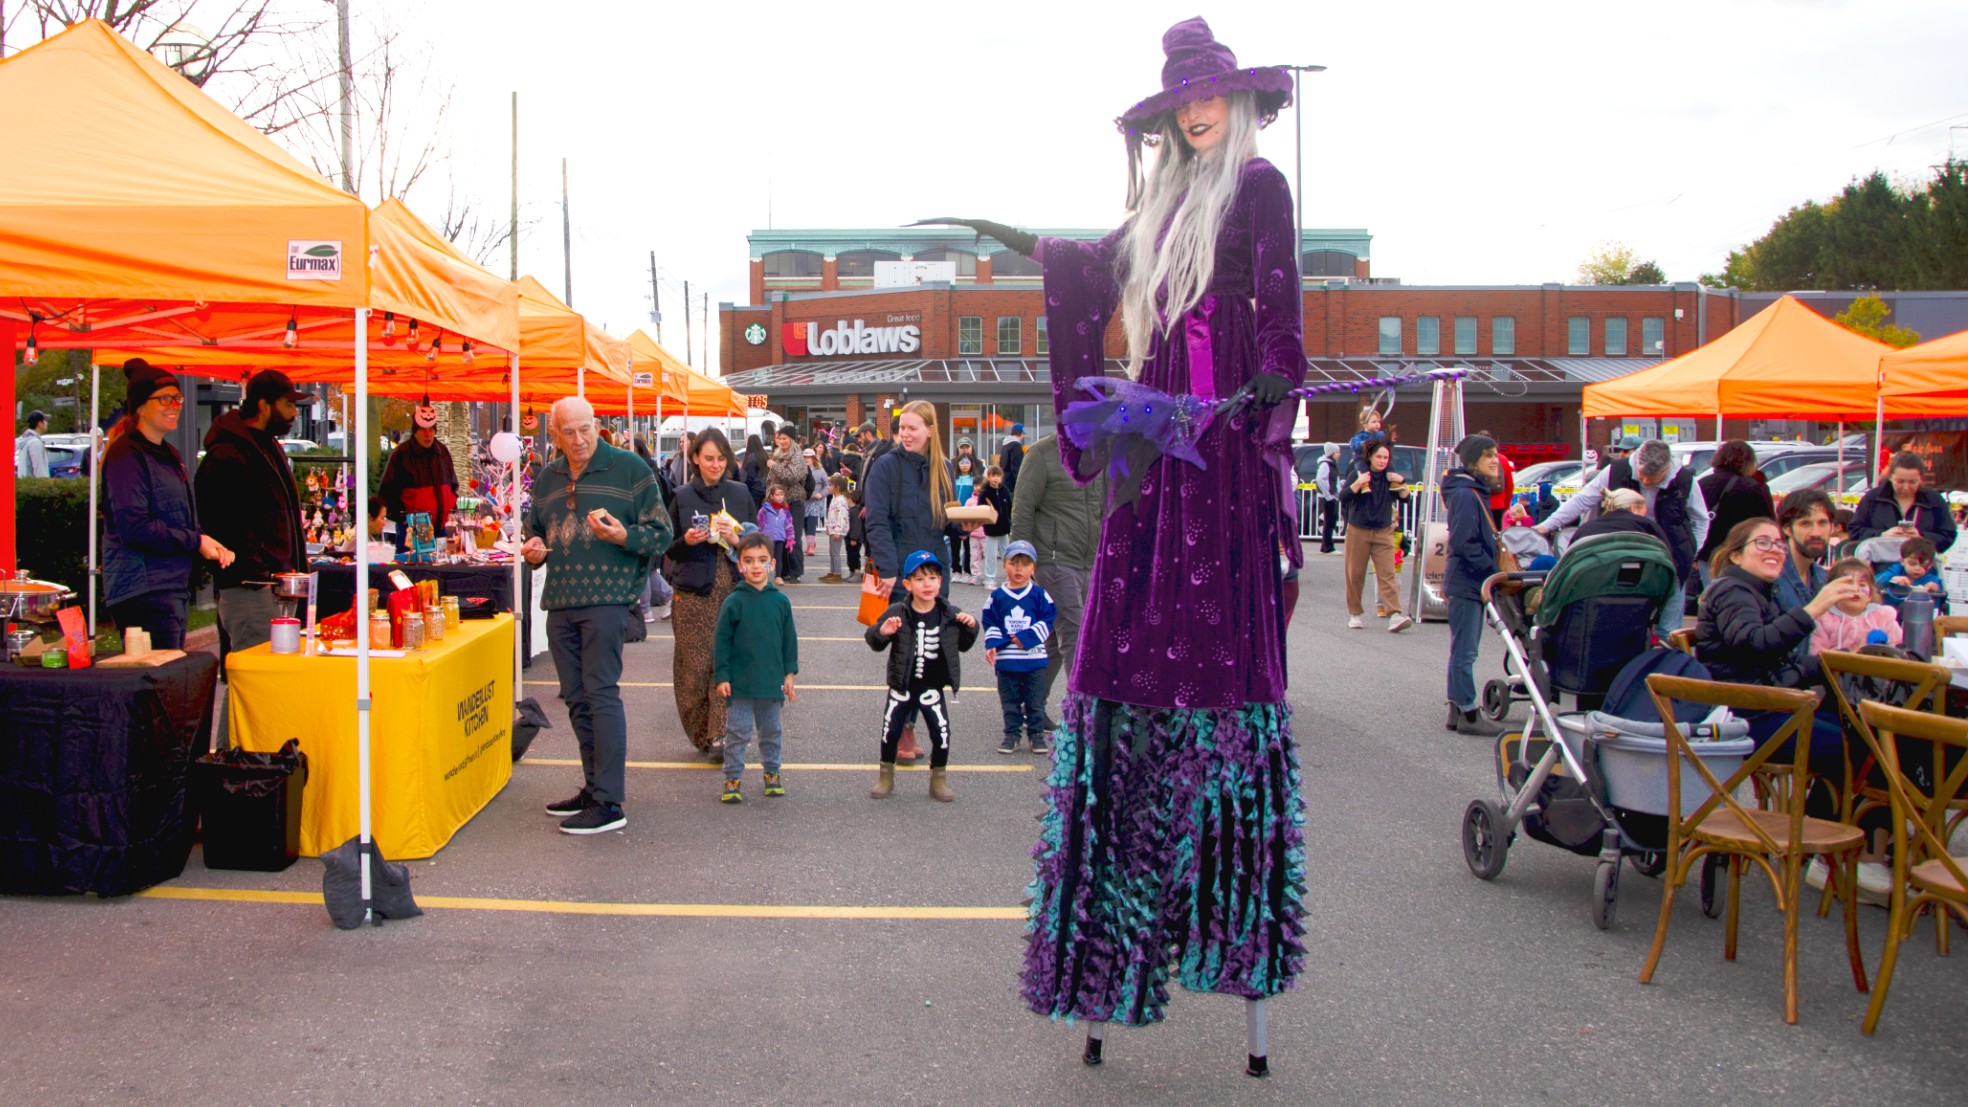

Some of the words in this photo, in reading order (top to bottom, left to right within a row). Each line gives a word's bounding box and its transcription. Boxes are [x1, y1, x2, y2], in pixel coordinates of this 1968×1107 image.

[290, 255, 336, 271] Eurmax
[887, 314, 905, 323] Great
[807, 319, 920, 356] Loblaws
[457, 679, 495, 722] WANDERLUST
[464, 705, 489, 736] KITCHEN
